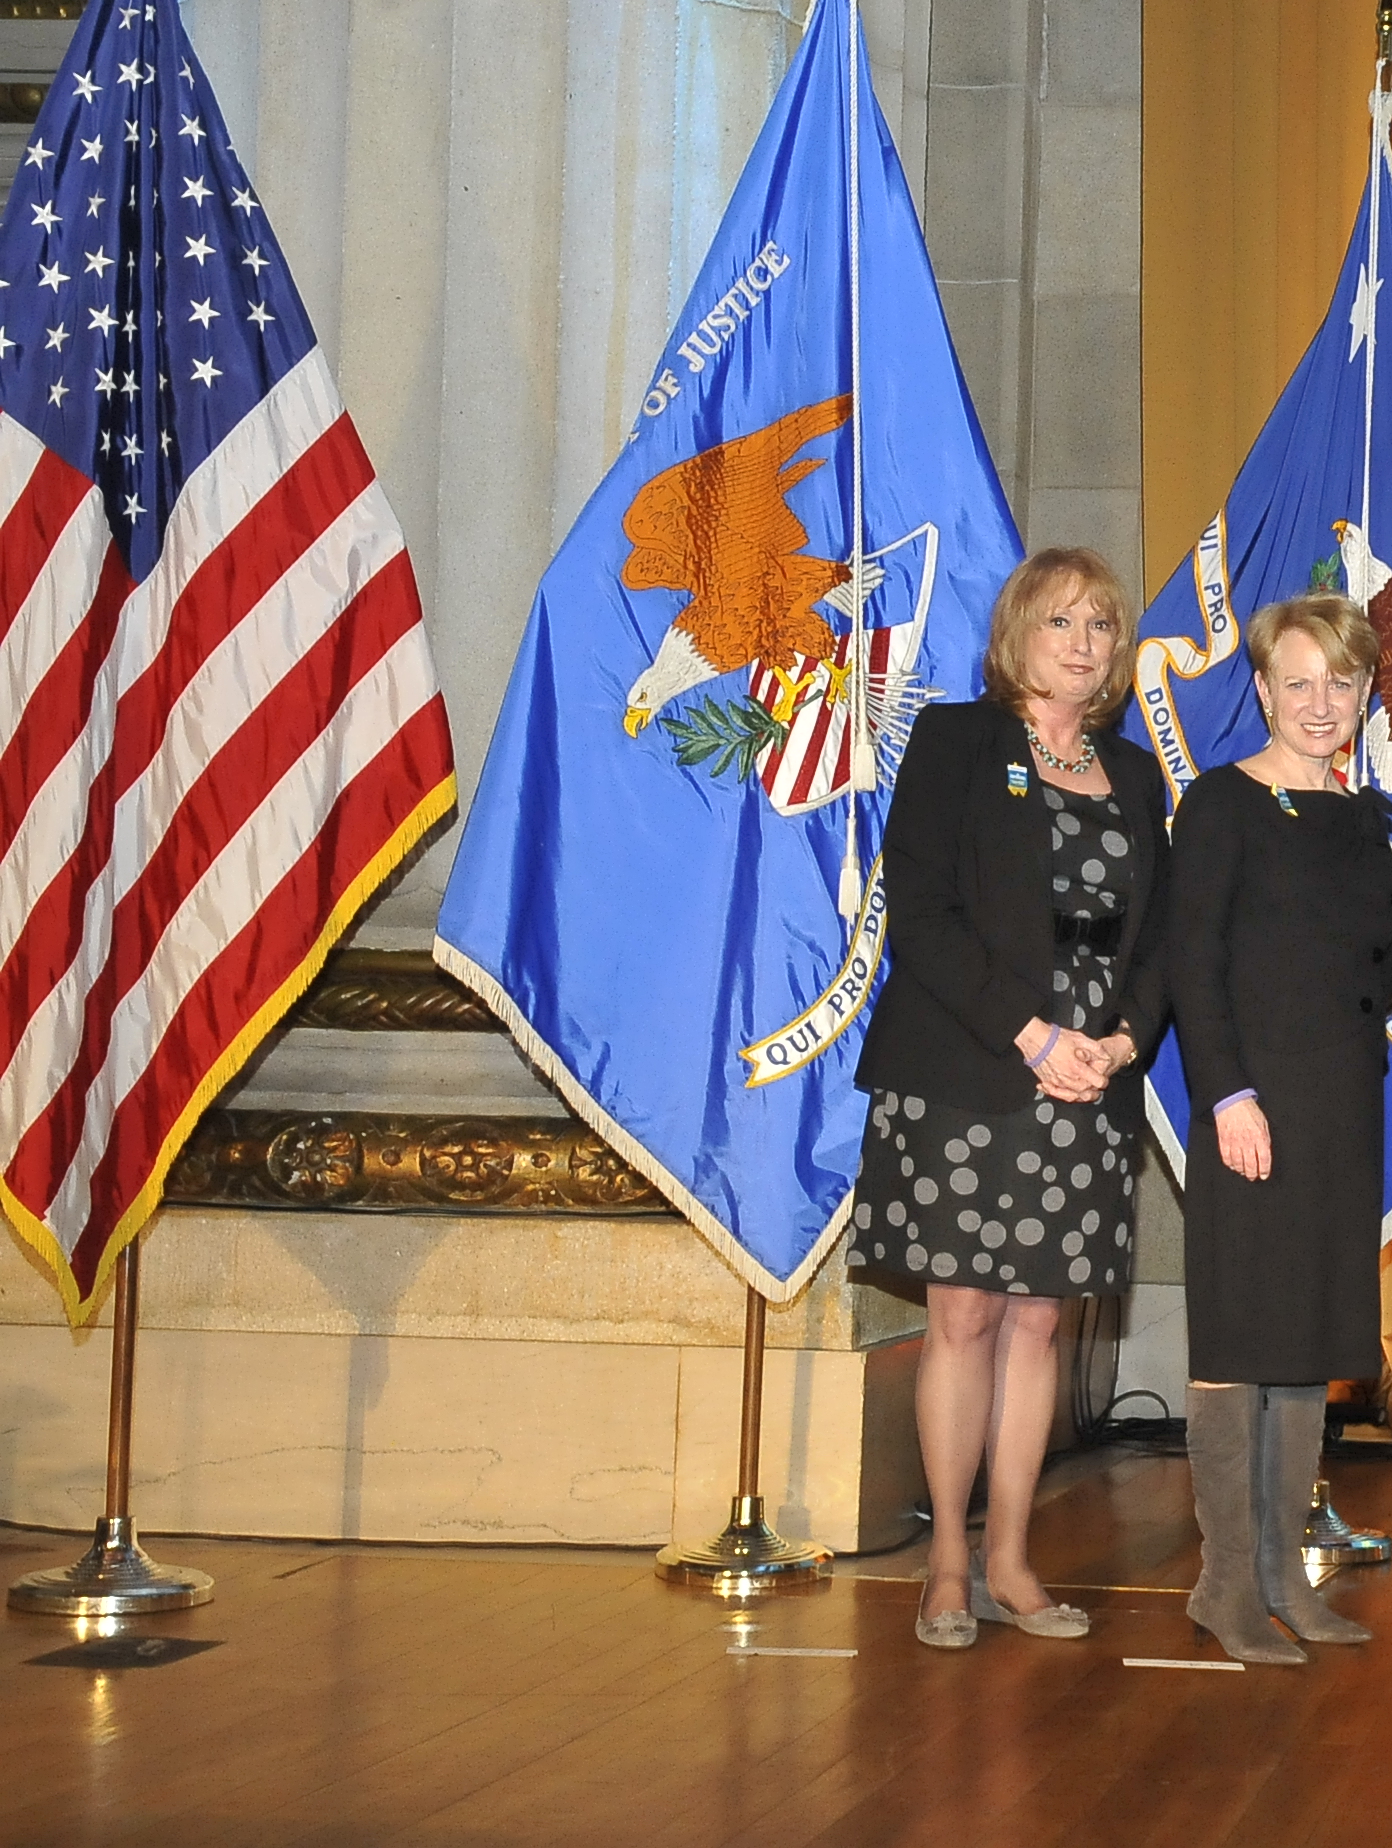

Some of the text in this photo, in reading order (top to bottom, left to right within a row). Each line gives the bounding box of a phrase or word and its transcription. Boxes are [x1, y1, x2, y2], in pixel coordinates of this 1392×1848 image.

[641, 240, 792, 417] OF JUSTICE
[1204, 582, 1228, 634] PRO
[765, 1019, 823, 1066] QUI
[827, 956, 867, 1019] PRO
